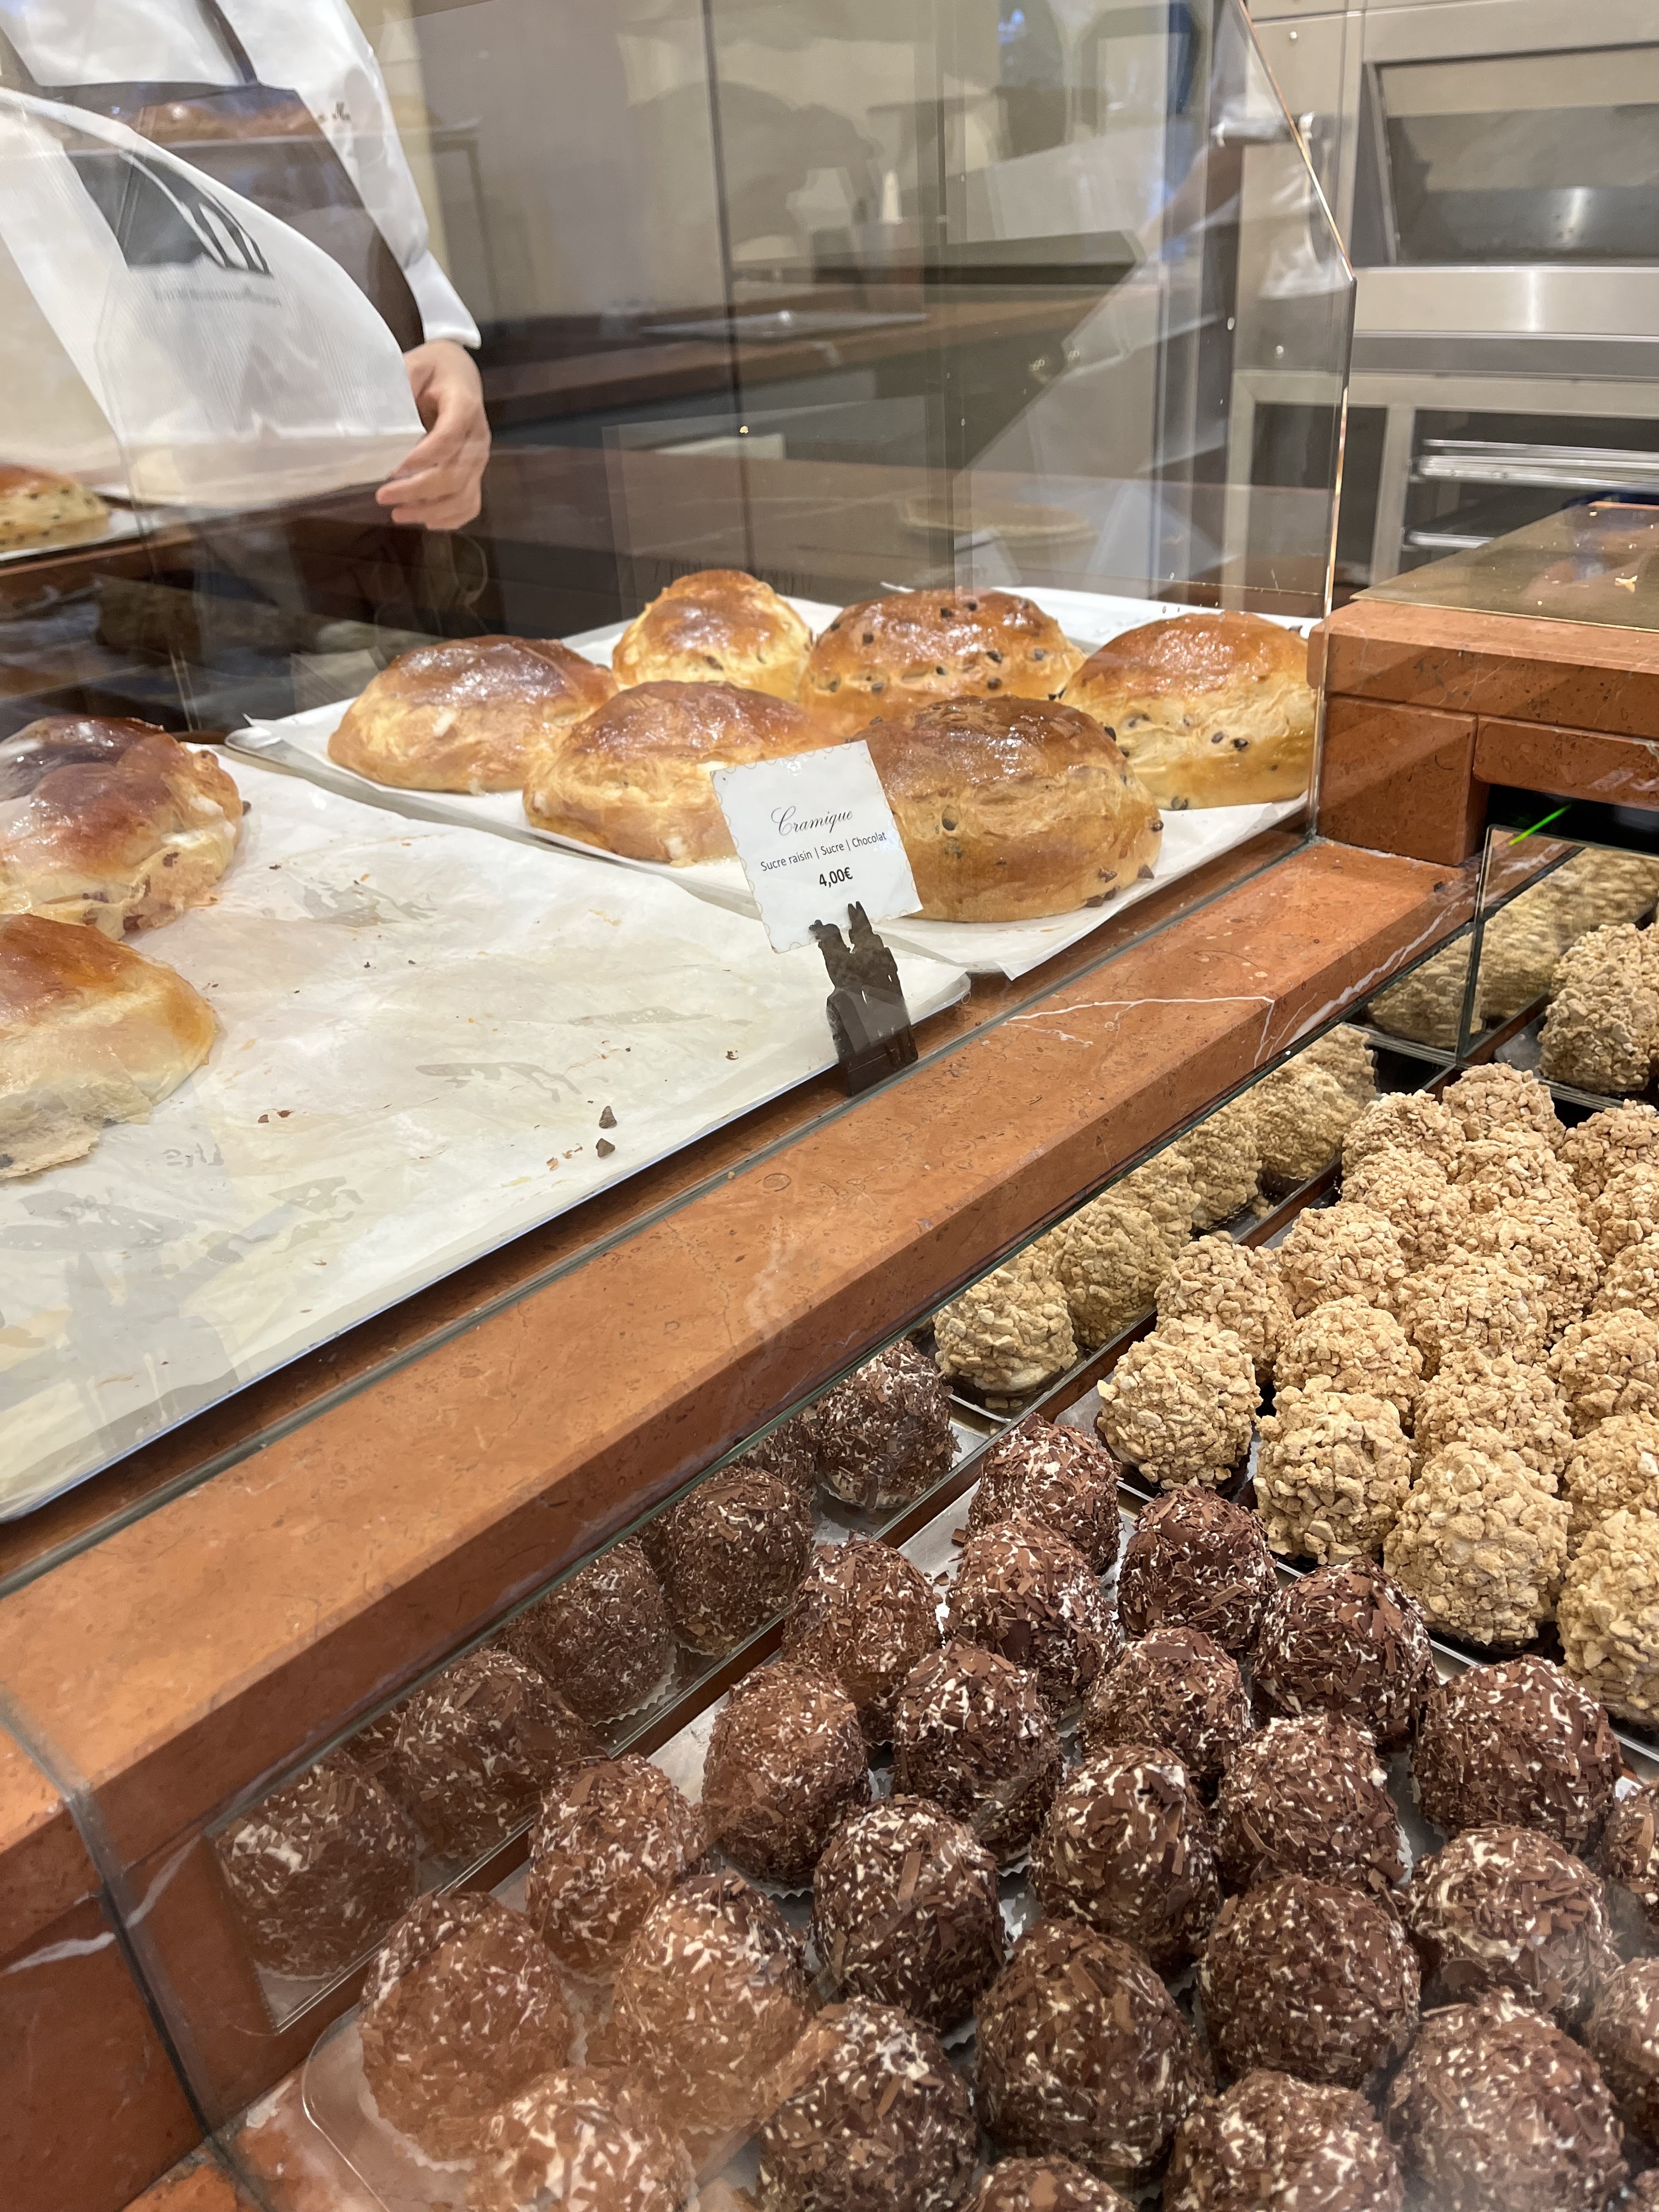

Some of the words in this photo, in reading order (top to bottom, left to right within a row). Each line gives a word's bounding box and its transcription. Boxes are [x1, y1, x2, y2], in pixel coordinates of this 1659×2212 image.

[771, 805, 853, 836] Cramique
[760, 857, 787, 871] Sucre
[788, 850, 812, 865] raisin
[821, 844, 845, 856] Sucre
[852, 831, 887, 848] Chocolat
[819, 867, 853, 888] 4,00€
